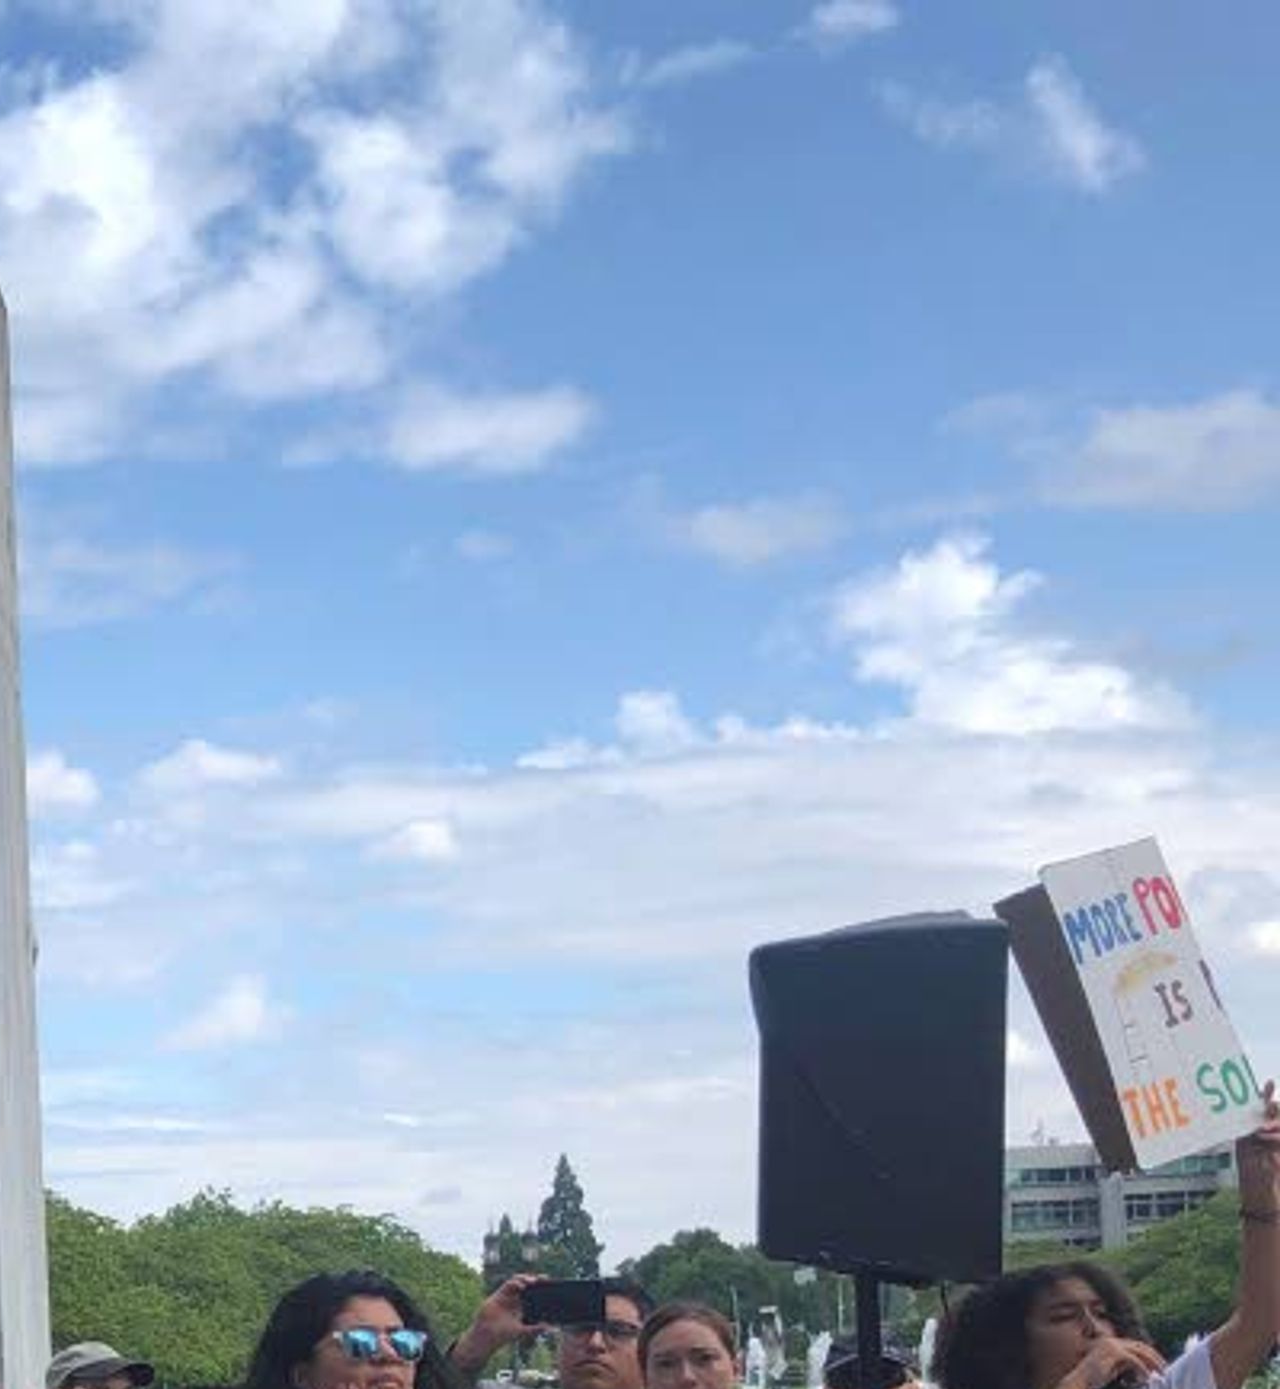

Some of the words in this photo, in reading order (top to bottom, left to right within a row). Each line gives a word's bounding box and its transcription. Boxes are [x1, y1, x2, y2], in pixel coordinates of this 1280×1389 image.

[1062, 892, 1143, 965] MORE
[1132, 876, 1190, 934] PO
[1153, 979, 1194, 1029] IS
[1123, 1077, 1191, 1139] THE
